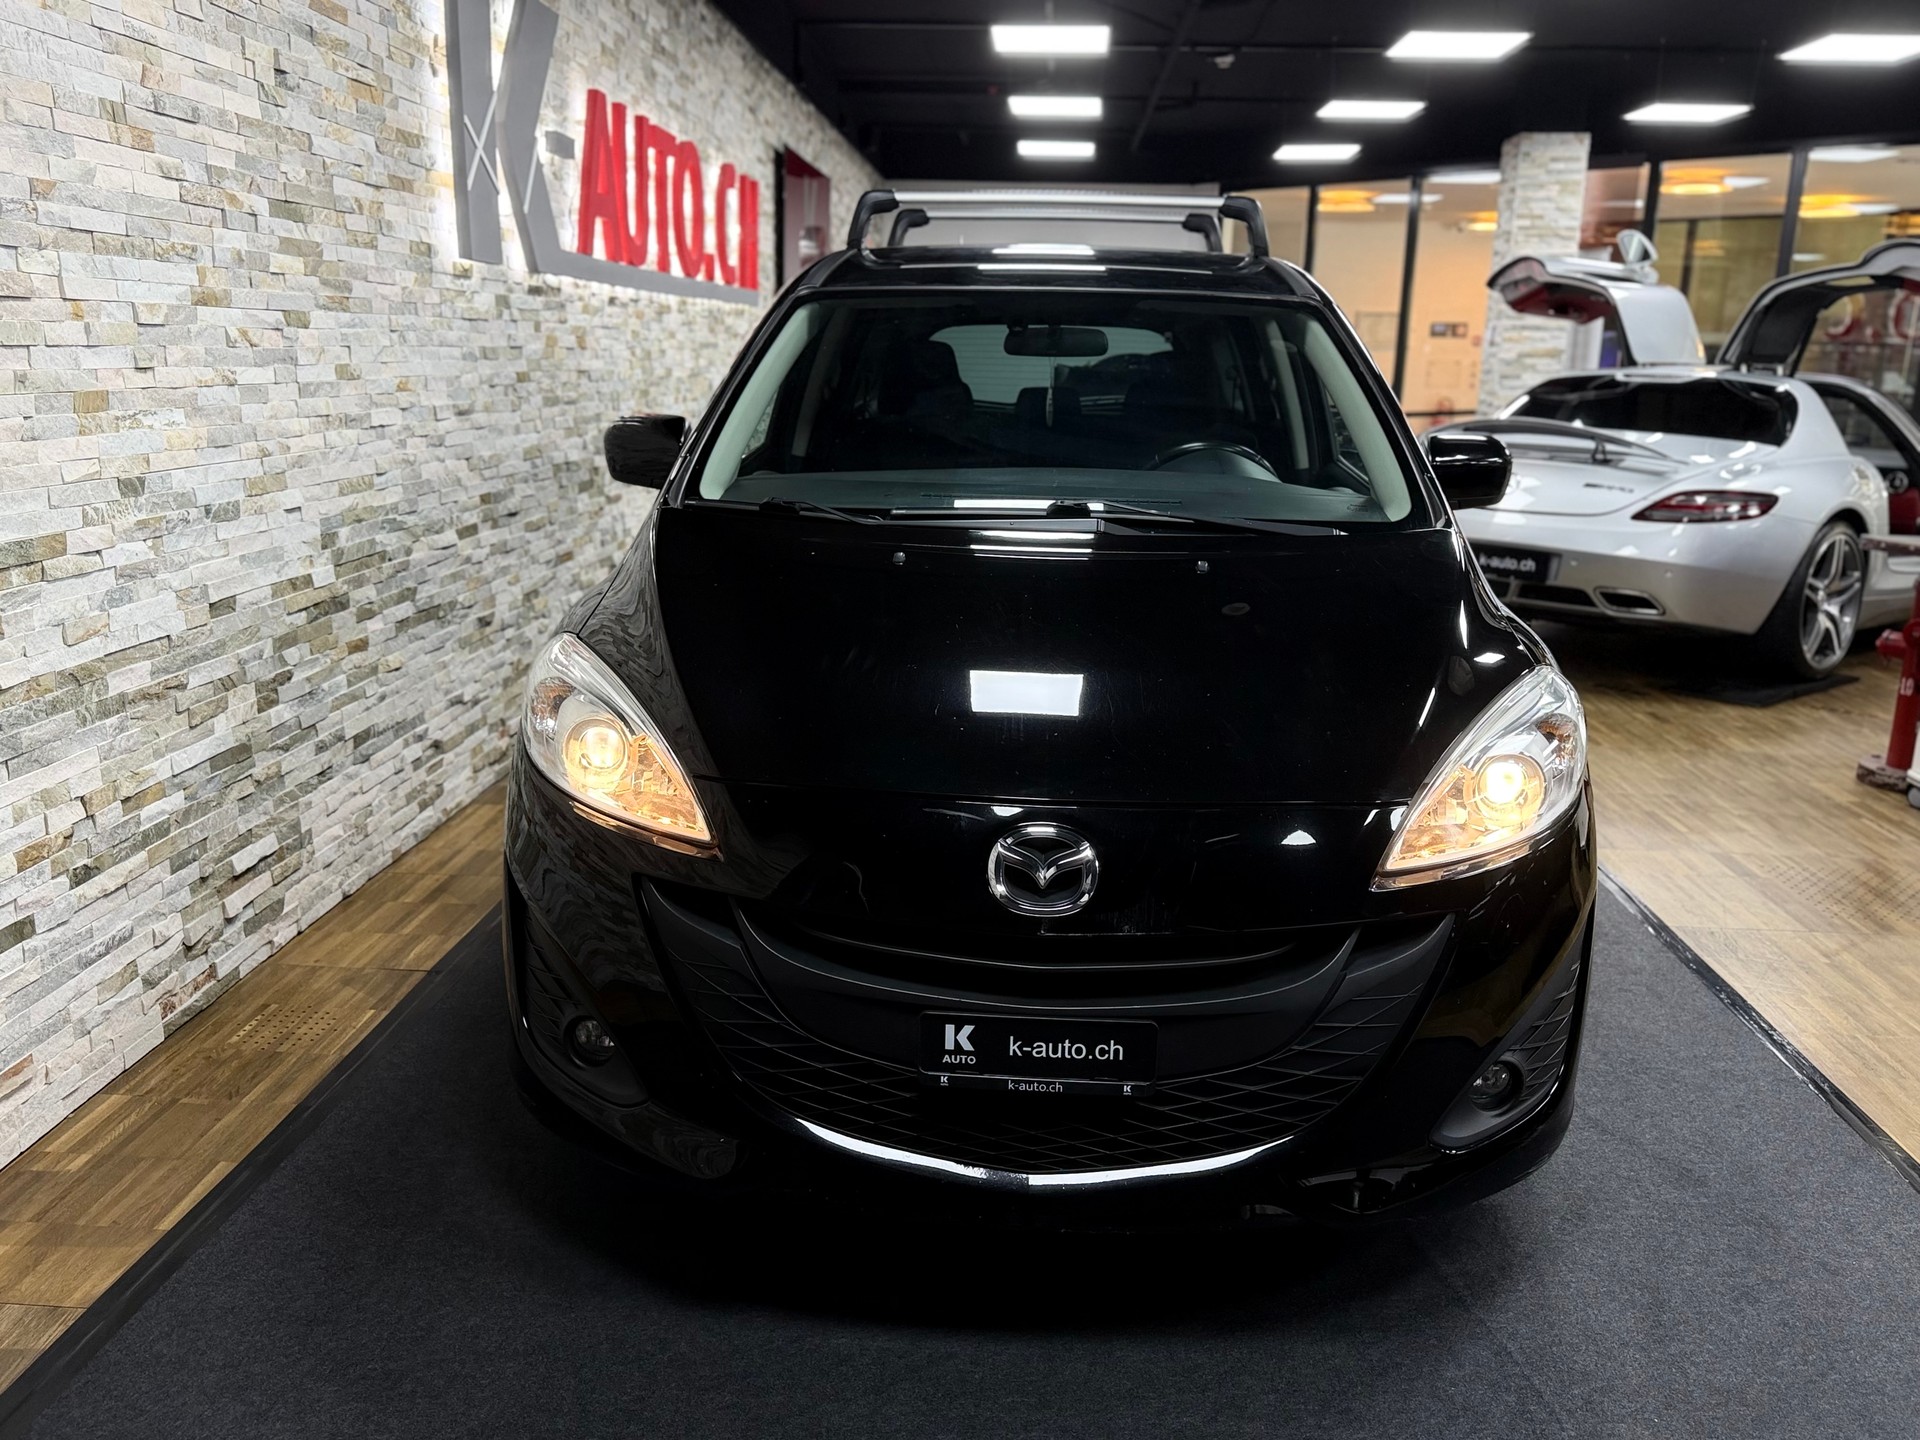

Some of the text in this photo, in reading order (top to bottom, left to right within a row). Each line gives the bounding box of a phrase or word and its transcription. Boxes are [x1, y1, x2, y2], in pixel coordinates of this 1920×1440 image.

[945, 1024, 975, 1051] K
[1009, 1036, 1124, 1061] k-auto.ch
[942, 1054, 976, 1065] AUTO
[1008, 1080, 1063, 1093] k-auto.ch
